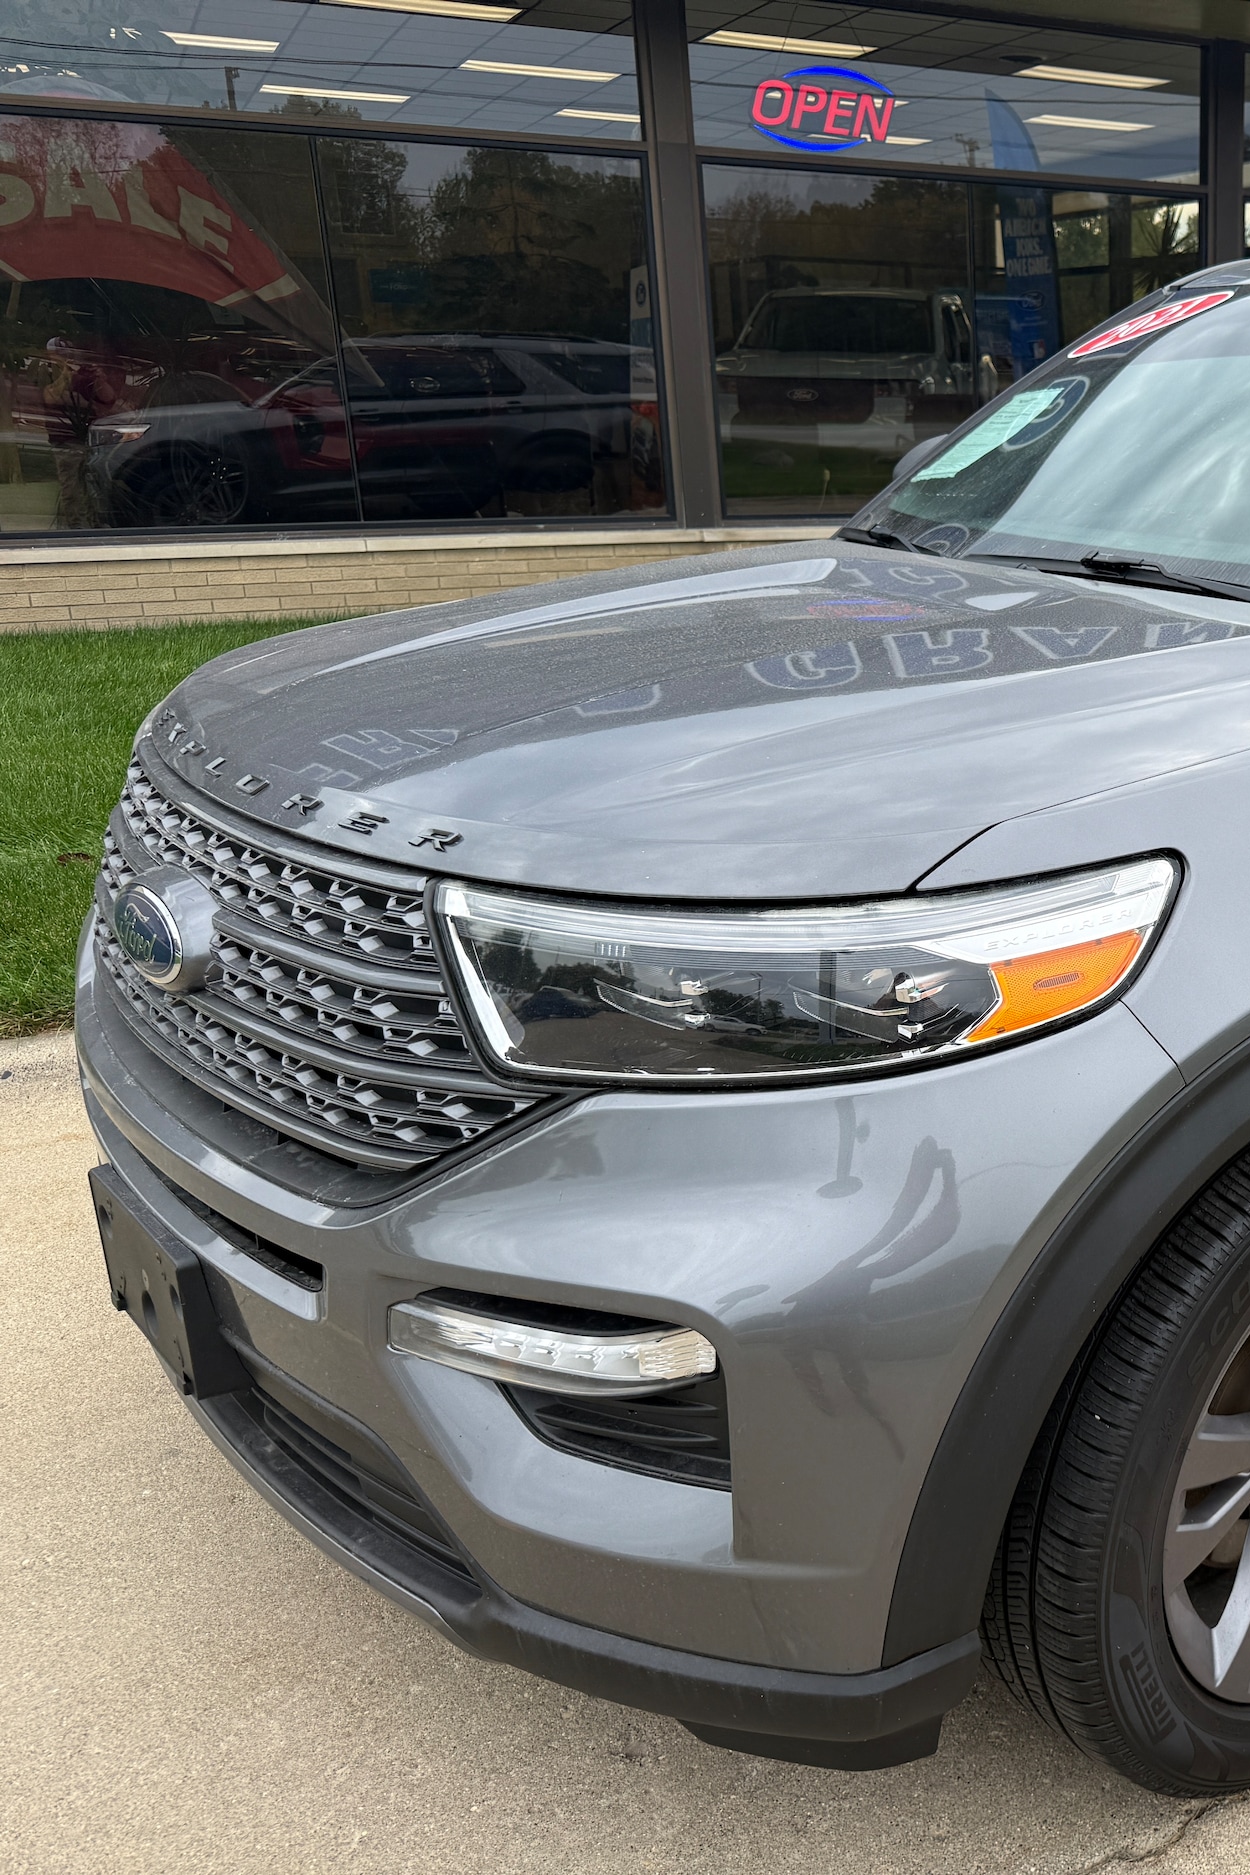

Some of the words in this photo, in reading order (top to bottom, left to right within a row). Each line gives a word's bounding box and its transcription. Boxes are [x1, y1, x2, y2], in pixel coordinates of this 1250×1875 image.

[752, 79, 895, 142] OPEN
[1088, 296, 1208, 351] 2021
[156, 707, 465, 853] EXPLORER
[983, 908, 1133, 952] EXPLORER
[1118, 1641, 1177, 1745] PIRELLI
